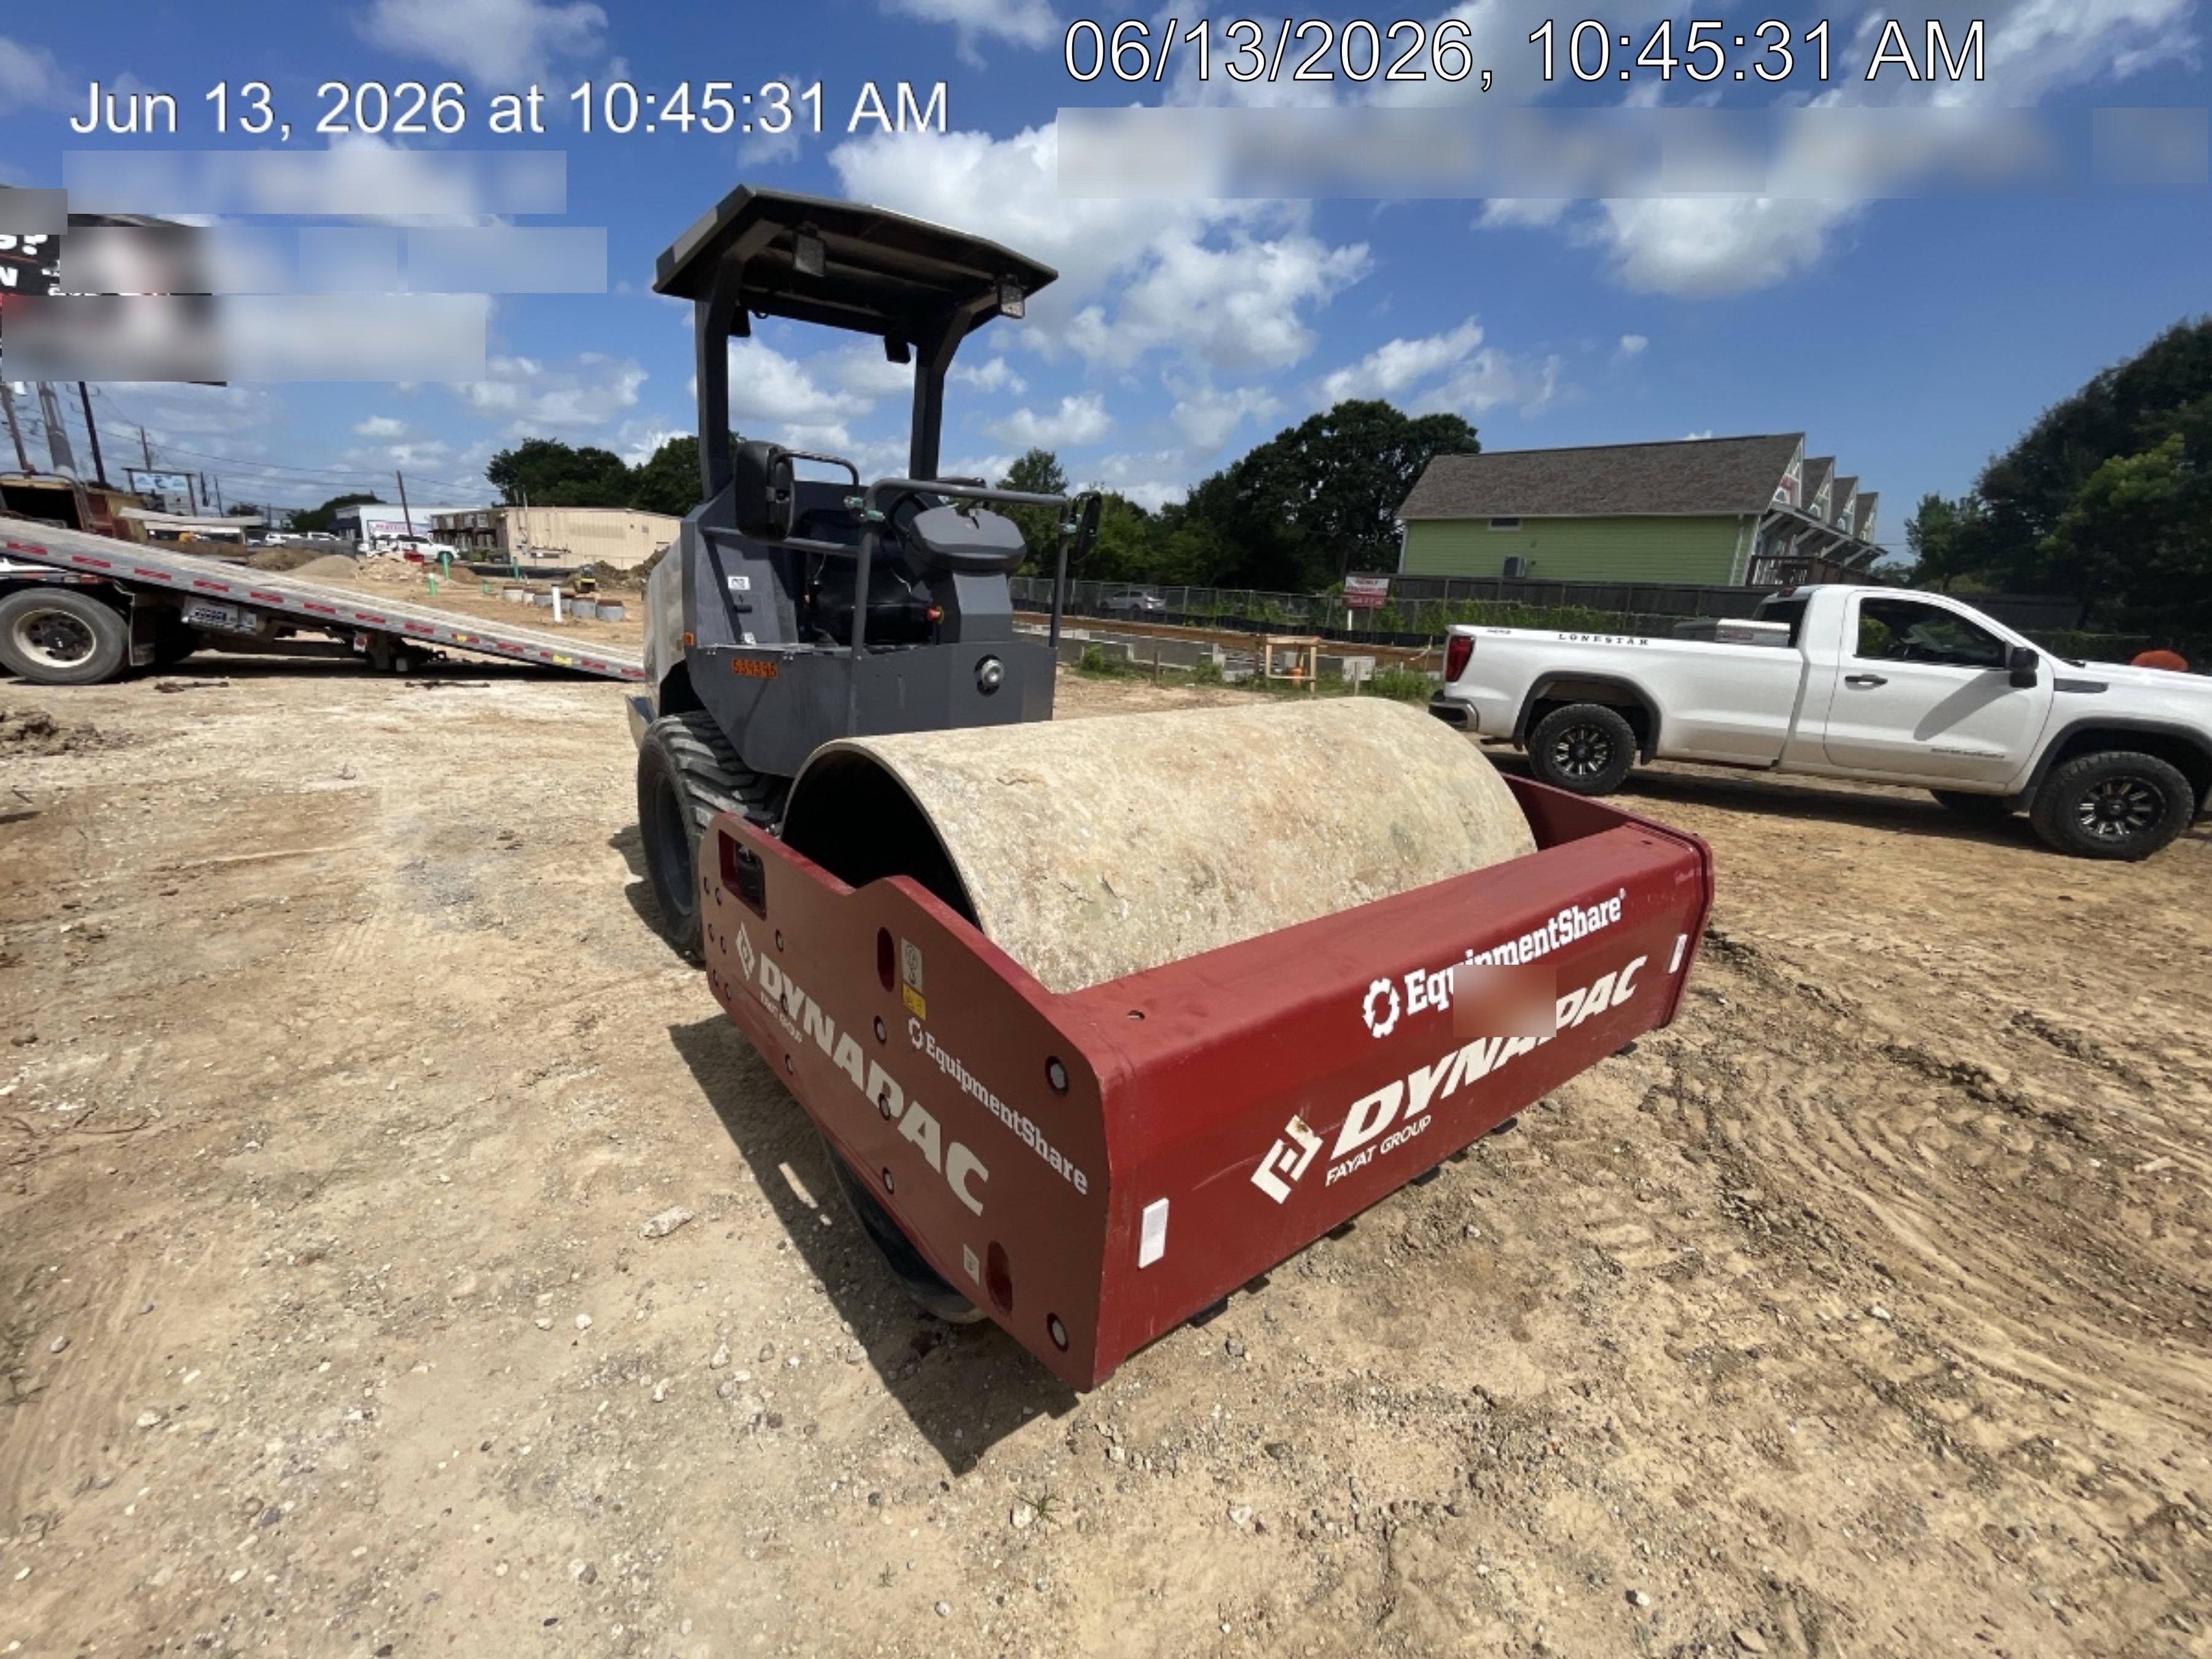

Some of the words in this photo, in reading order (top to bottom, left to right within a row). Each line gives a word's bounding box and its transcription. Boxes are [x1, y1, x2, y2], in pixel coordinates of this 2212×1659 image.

[759, 952, 989, 1217] DYNAPAC
[925, 1031, 1088, 1196] EquipmentShare
[1325, 1144, 1378, 1187] FAYAT
[1379, 1114, 1432, 1155] GROUP
